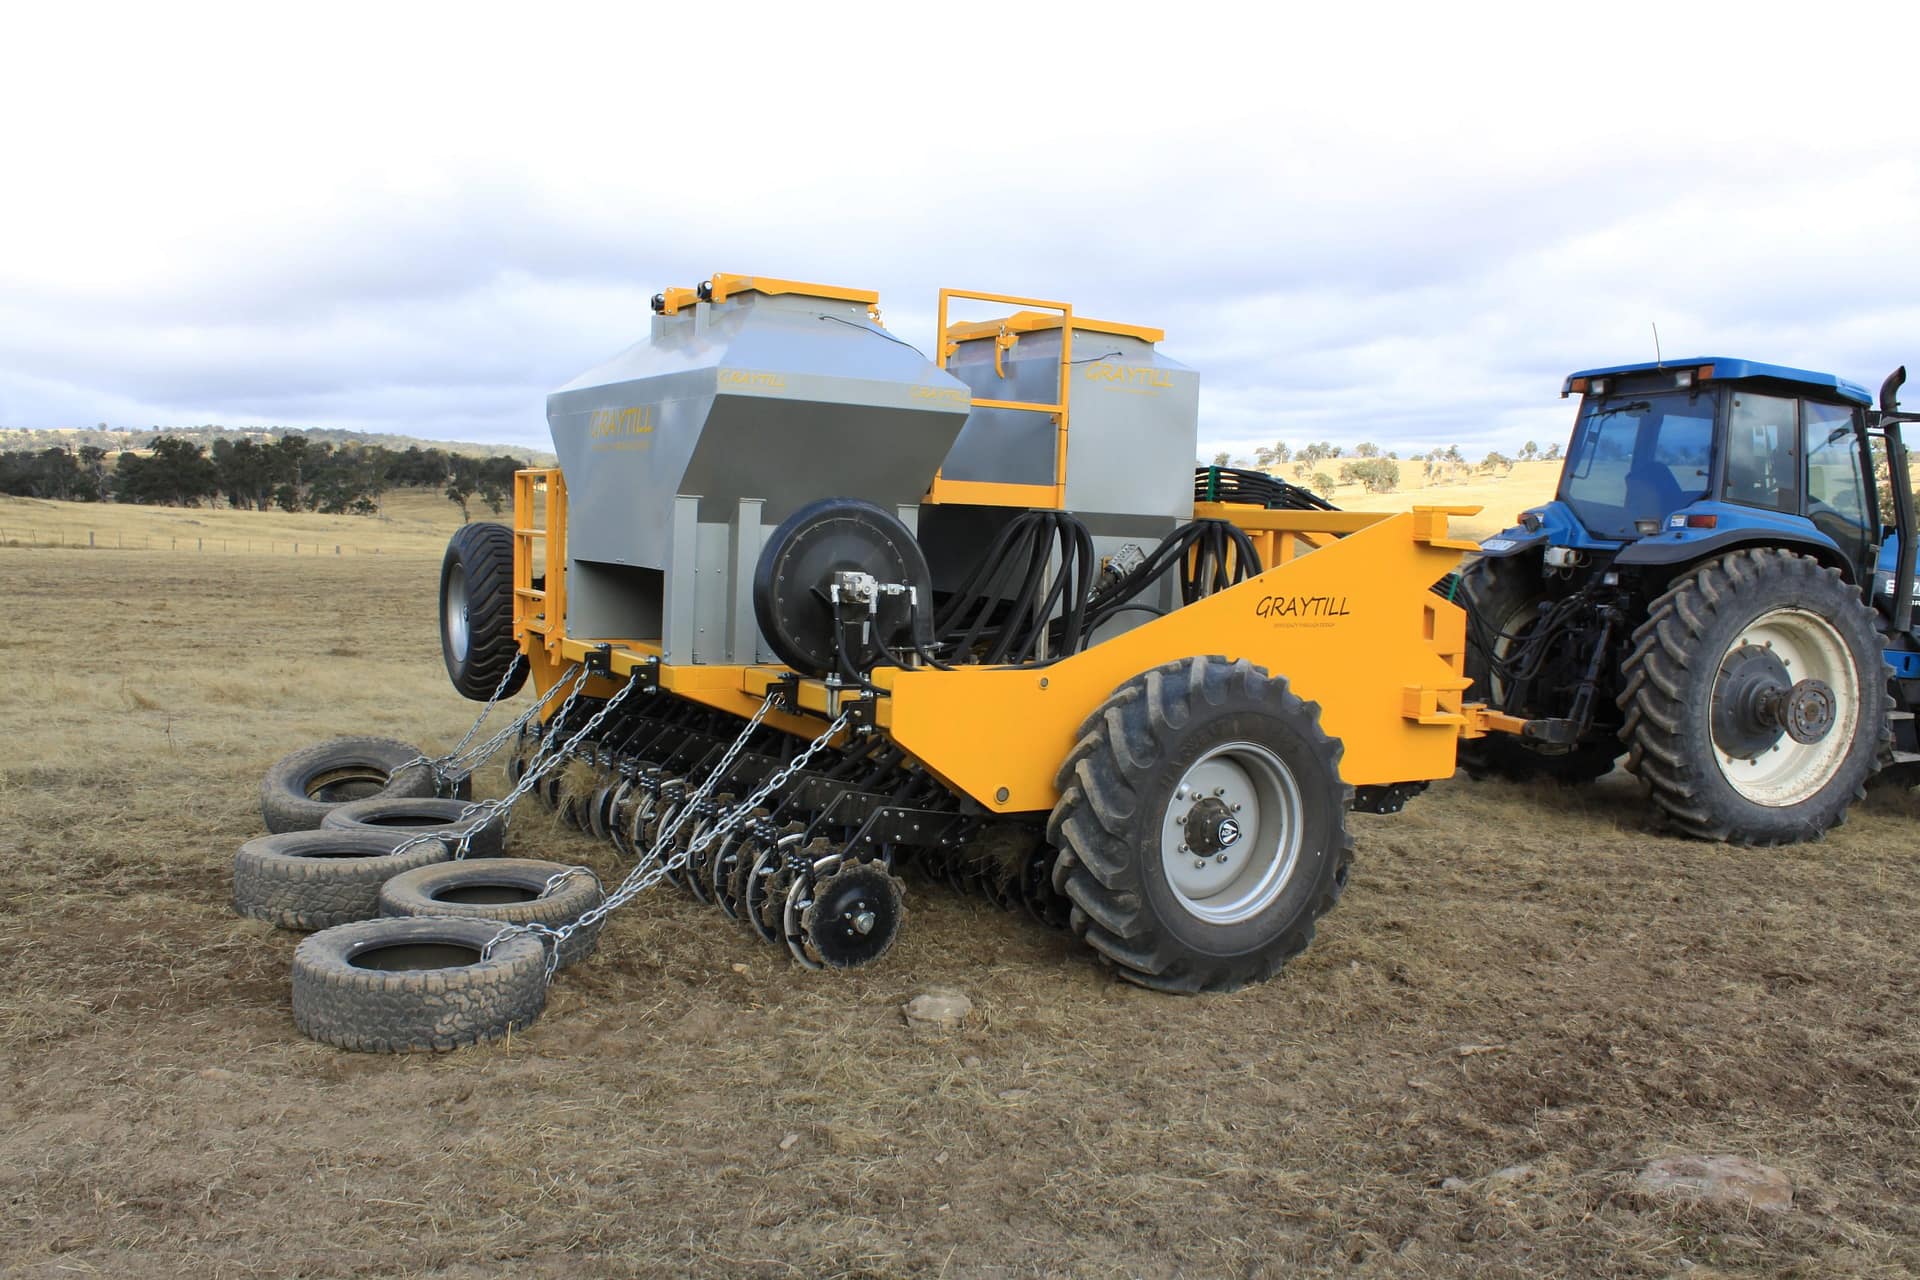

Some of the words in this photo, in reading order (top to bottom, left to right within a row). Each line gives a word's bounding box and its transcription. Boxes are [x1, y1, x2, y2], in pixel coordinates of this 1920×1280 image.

[719, 368, 785, 387] GRAYTILL
[1085, 361, 1175, 388] GRAYTILL
[589, 407, 654, 439] GRAYTILL
[1256, 596, 1350, 618] GRAYTILL
